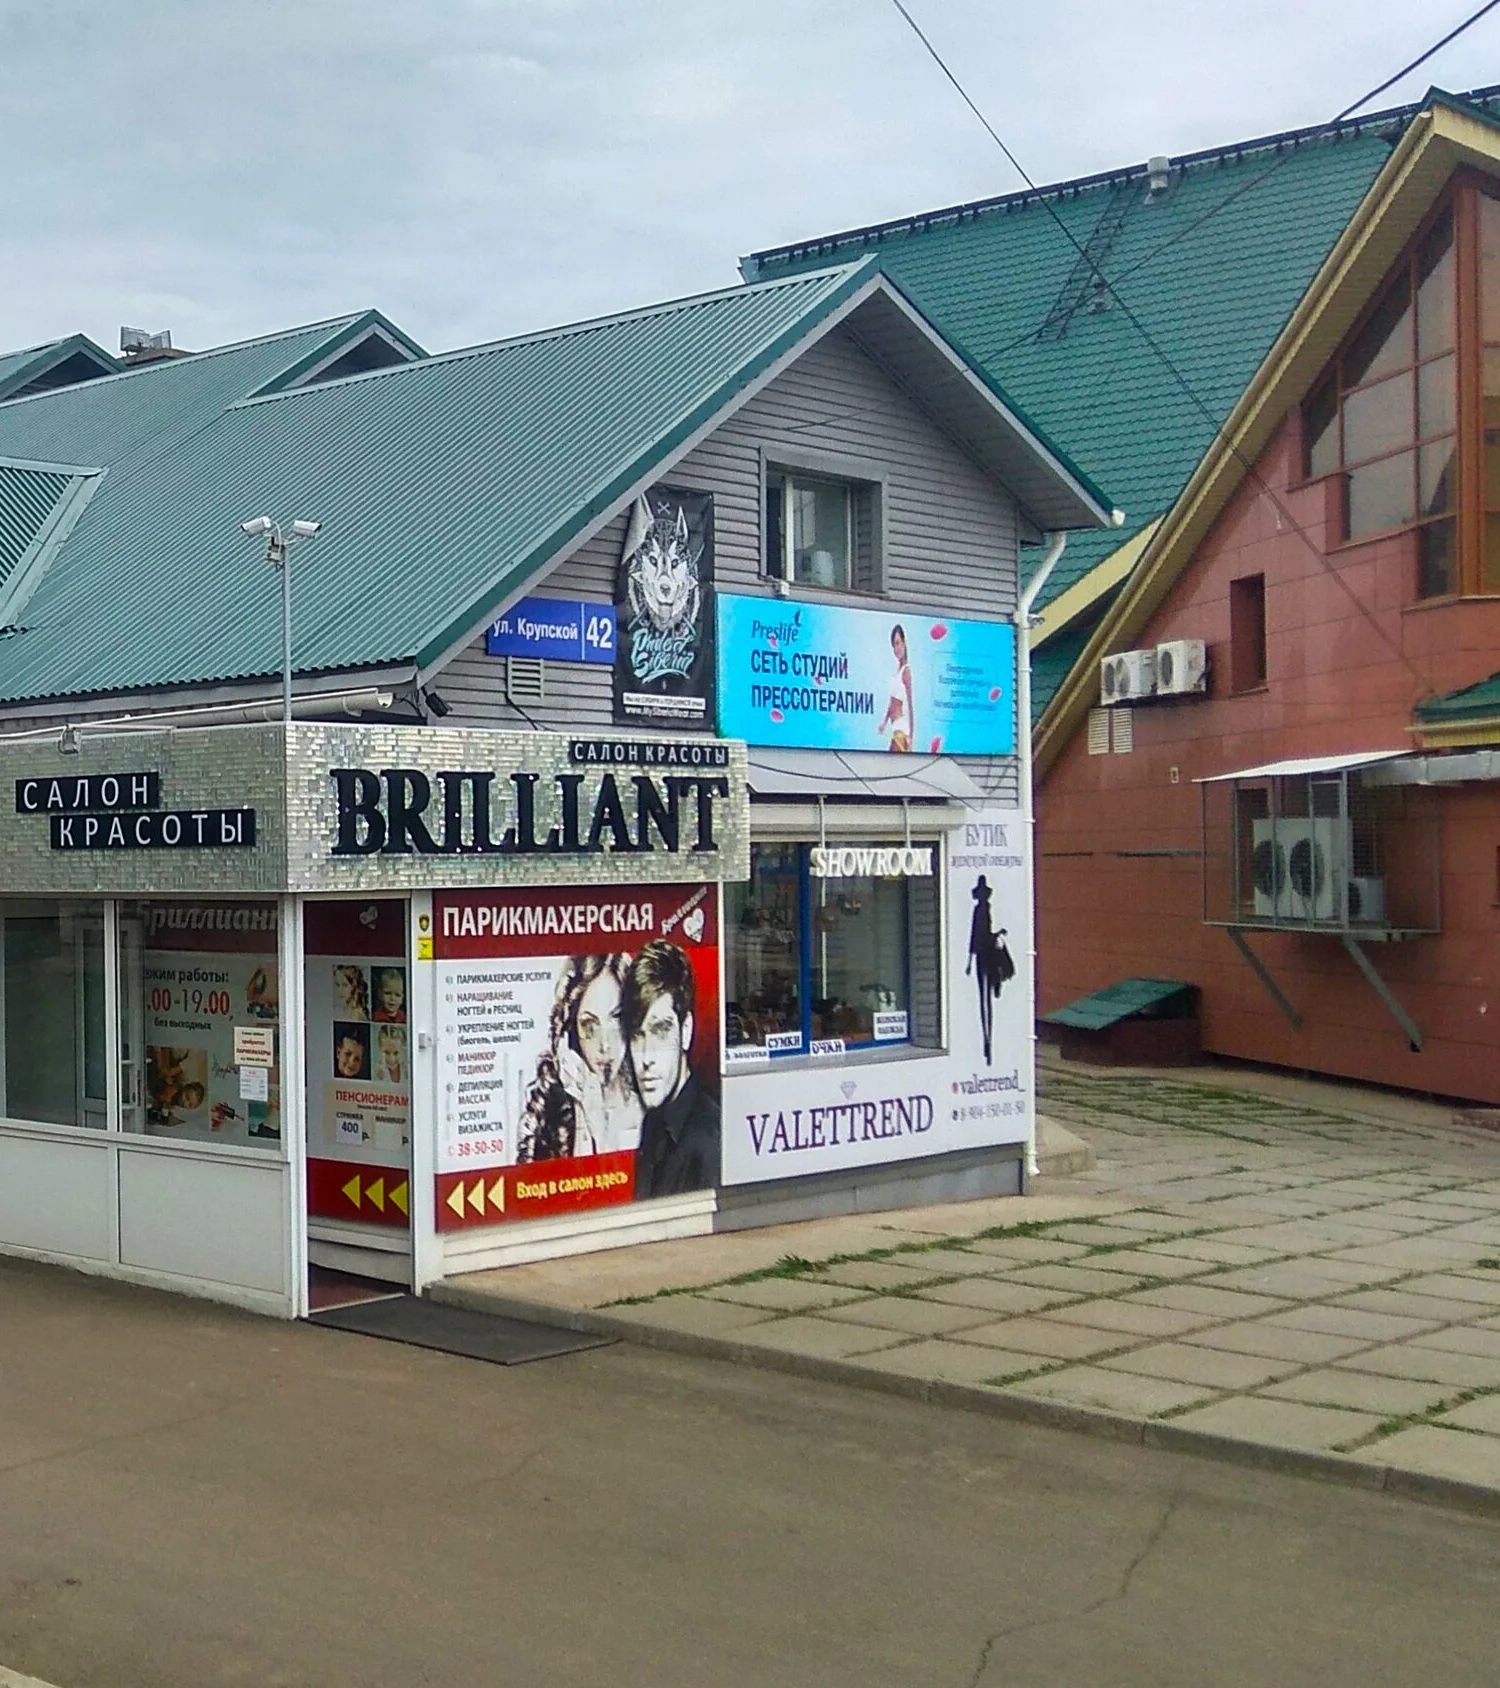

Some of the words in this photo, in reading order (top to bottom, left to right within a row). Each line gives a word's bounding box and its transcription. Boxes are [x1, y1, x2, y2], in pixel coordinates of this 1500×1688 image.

[493, 620, 513, 637] ул.
[517, 617, 578, 641] Крупской
[586, 616, 613, 648] 42
[752, 620, 799, 646] Preslife
[751, 649, 789, 675] СЕТЬ
[792, 652, 849, 682] СТУДИЙ
[752, 685, 875, 715] ПРЕССОТЕРАПИИ
[574, 743, 638, 762] САЛОН
[645, 745, 726, 765] КРАСОТЫ
[23, 775, 150, 809] САЛОН
[329, 768, 729, 854] BRILLIANT
[59, 811, 243, 846] КРАСОТЫ
[965, 824, 1008, 847] БУТИК
[810, 847, 933, 878] SHOWROOM
[443, 903, 654, 936] ПАРИКМАХЕРСКАЯ
[178, 968, 229, 984] работы:
[456, 973, 524, 984] ПАРИКМАХЕРСКИЕ
[526, 972, 552, 981] УСЛУГИ
[457, 991, 513, 1002] НАРАЩИВАНИЕ
[457, 1004, 486, 1016] НОГТЕЙ
[493, 1004, 522, 1015] РЕСНИЦ
[457, 1021, 505, 1033] УКРЕПЛЕНИЕ
[506, 1018, 535, 1030] НОГТЕЙ
[768, 1036, 800, 1048] СУМКИ
[812, 1042, 842, 1055] ОЧКИ
[458, 1051, 496, 1062] МАНИКЮР
[458, 1064, 494, 1075] ПЕДИКЮР
[458, 1079, 503, 1092] ДЕПИЛЯЦИЯ
[336, 1090, 408, 1106] ПЕНСИОНЕРАМ
[458, 1094, 491, 1105] МАССАЖ
[458, 1110, 486, 1121] УСЛУГИ
[341, 1121, 358, 1133] 400
[458, 1121, 503, 1135] ВИЗАЖИСТА
[746, 1094, 934, 1156] VALETTREND
[457, 1139, 503, 1157] 38-50-50
[516, 1181, 547, 1199] Вход
[549, 1181, 556, 1194] в
[559, 1176, 593, 1194] салон
[595, 1171, 628, 1190] здесь
